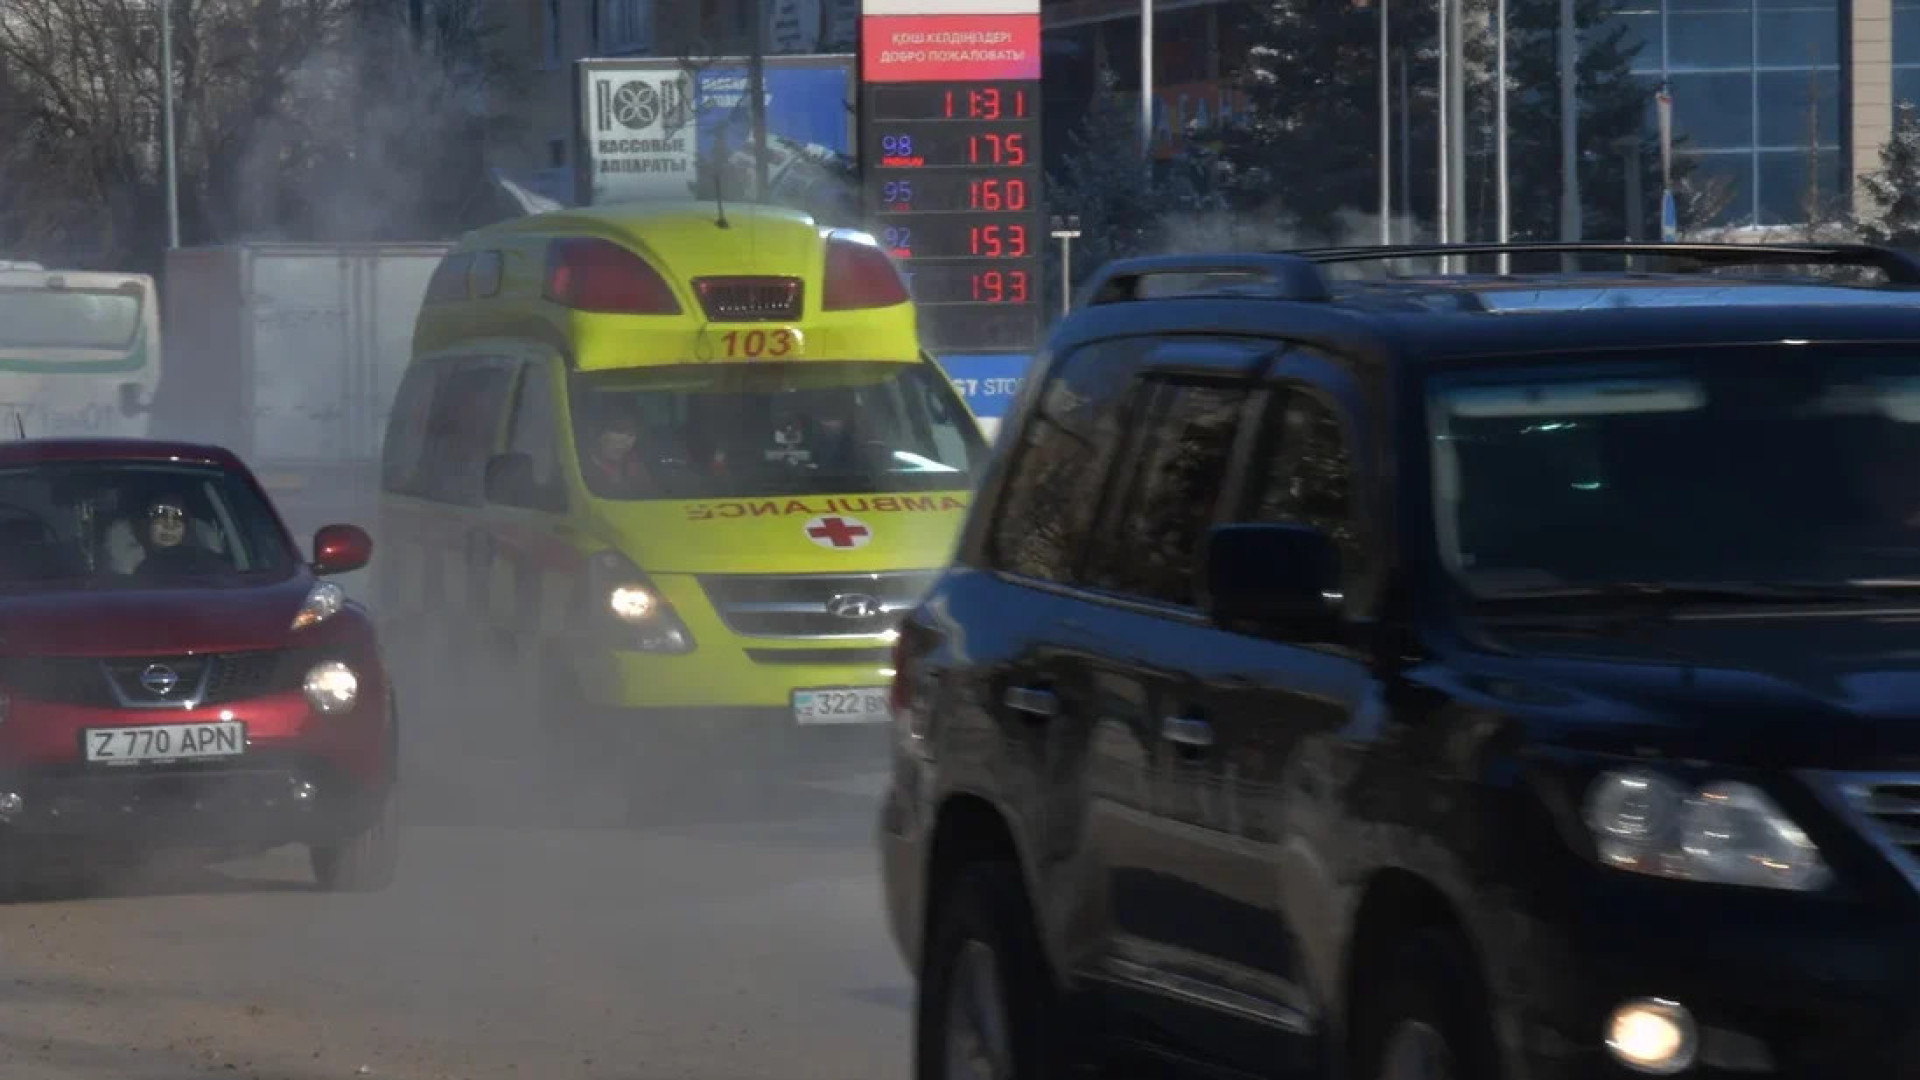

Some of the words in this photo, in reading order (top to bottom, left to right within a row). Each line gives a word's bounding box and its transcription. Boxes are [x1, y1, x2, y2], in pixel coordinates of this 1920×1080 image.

[880, 50, 926, 64] ДОБРО
[945, 89, 1026, 119] 11:31
[599, 138, 685, 155] КАССОВЫЕ
[882, 135, 912, 157] 98
[969, 134, 1024, 165] 175
[600, 157, 687, 173] АППАРАТЫ
[883, 181, 912, 202] 95
[969, 179, 1025, 211] 160
[971, 225, 1025, 257] 153
[972, 270, 1027, 303] 193
[721, 329, 792, 358] 103
[818, 692, 859, 715] 322
[95, 732, 114, 757] Z
[123, 730, 171, 756] 770
[181, 726, 236, 752] APN
